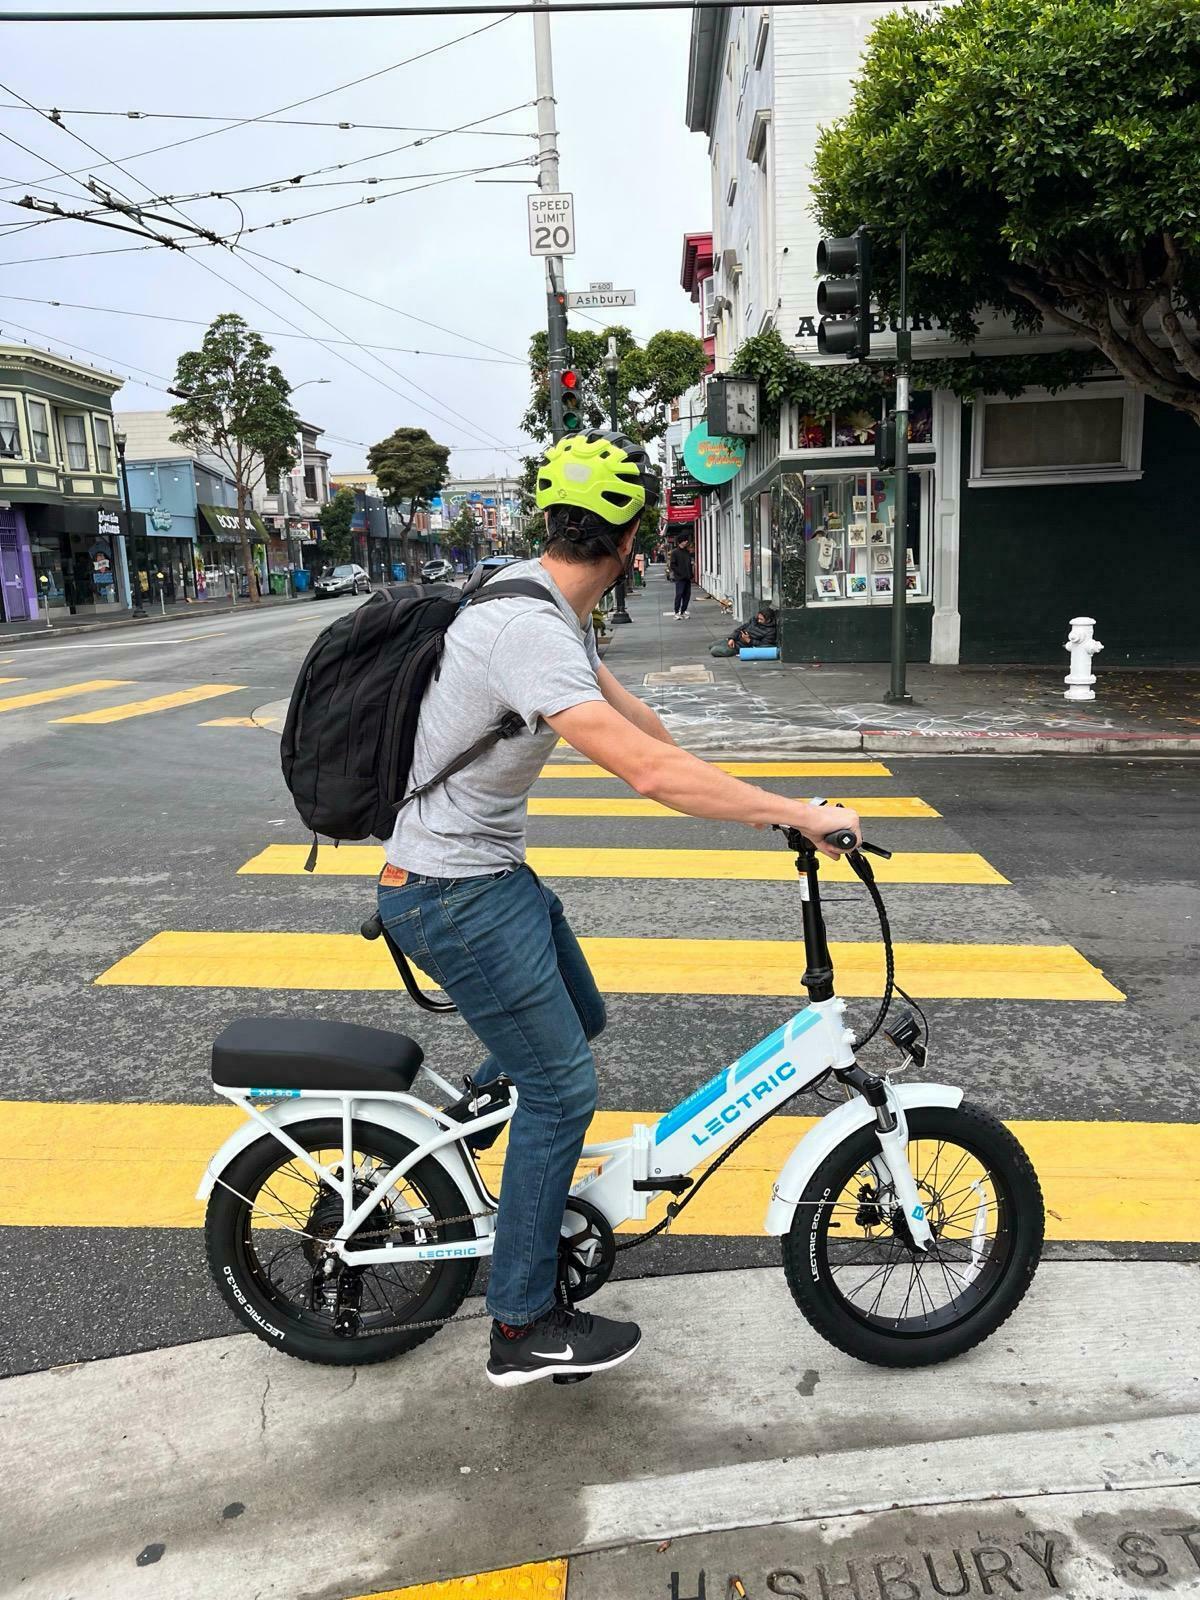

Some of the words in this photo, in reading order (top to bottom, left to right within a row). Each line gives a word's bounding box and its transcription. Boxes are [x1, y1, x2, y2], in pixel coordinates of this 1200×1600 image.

[532, 200, 570, 211] SPEED
[536, 213, 566, 223] LIMIT
[535, 226, 570, 248] 20
[576, 294, 627, 304] Ashbury
[691, 1061, 797, 1146] LECTRIC
[418, 1247, 477, 1259] LECTRIC
[810, 1231, 820, 1282] LECTRIC
[223, 1265, 247, 1305] 20x3.0
[244, 1303, 286, 1340] LECTRIC
